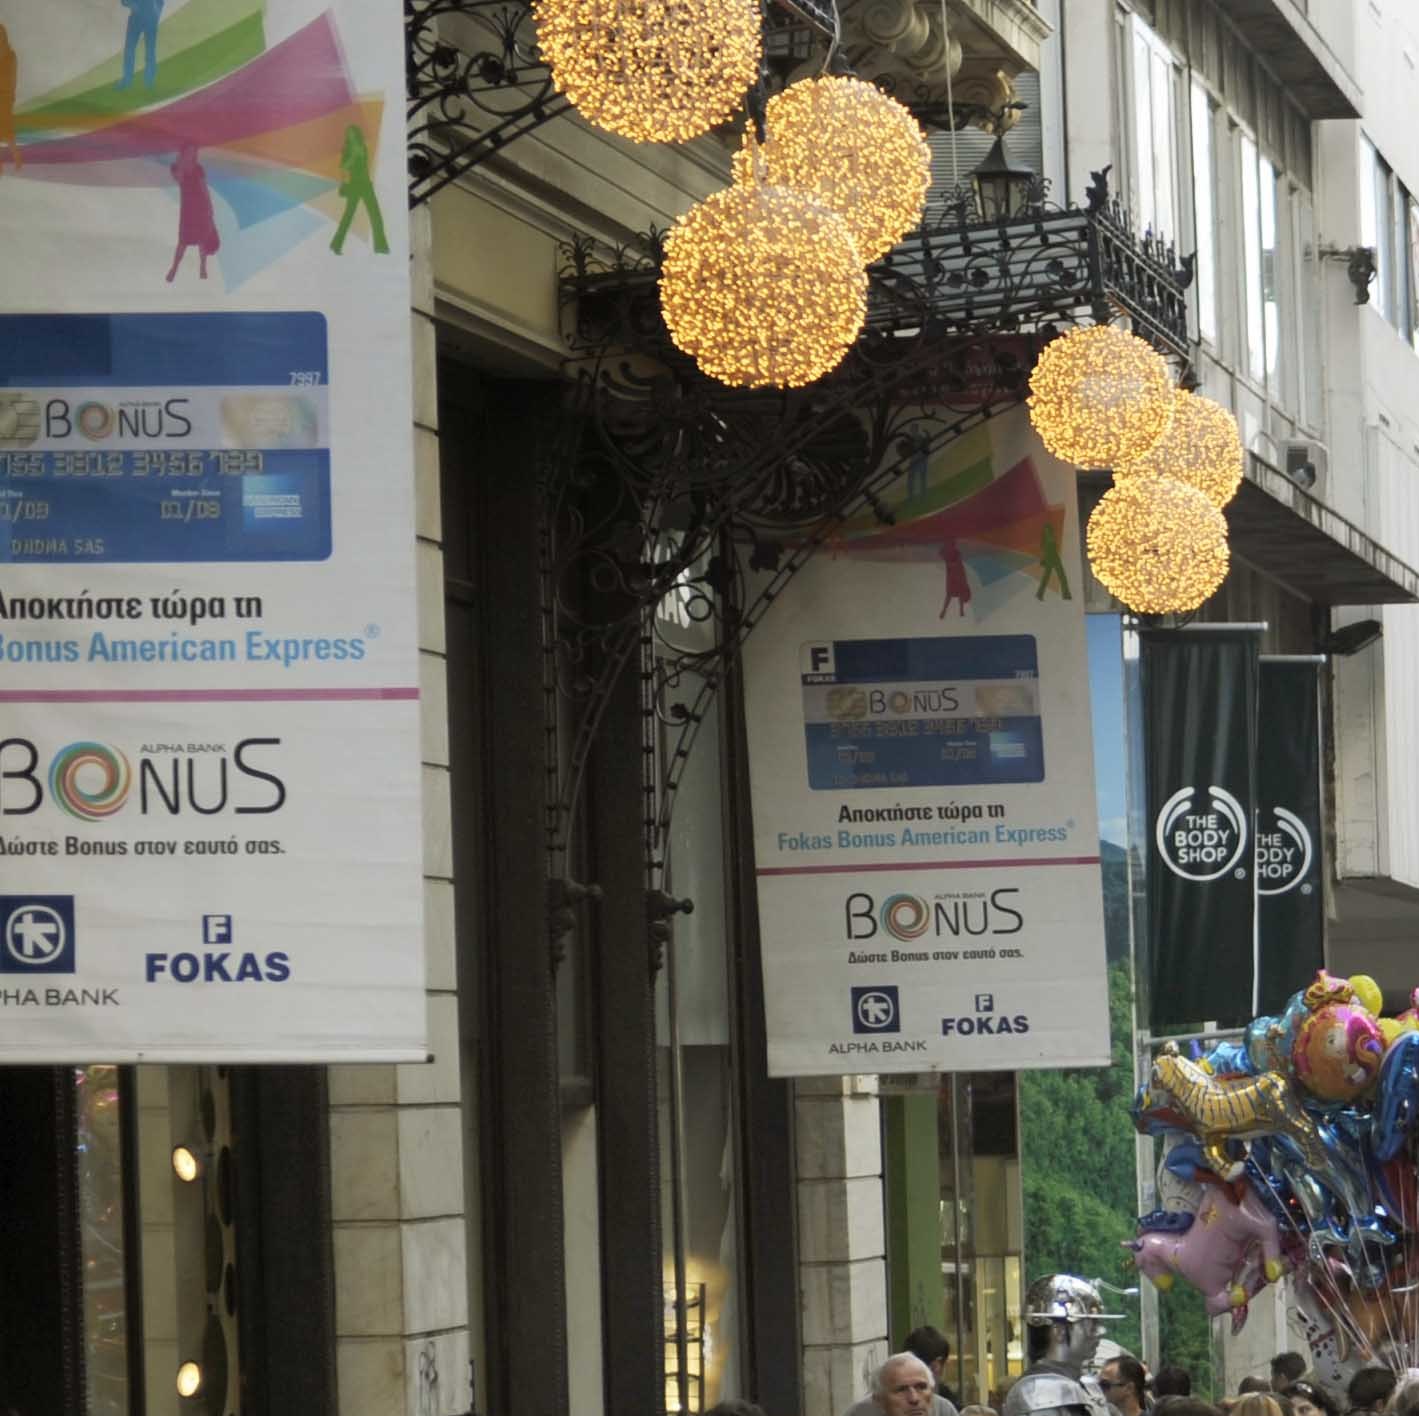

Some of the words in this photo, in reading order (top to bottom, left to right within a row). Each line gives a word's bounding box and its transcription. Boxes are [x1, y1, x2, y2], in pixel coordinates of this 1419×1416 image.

[46, 399, 192, 440] BONUS
[150, 588, 225, 625] τώρα
[234, 597, 263, 619] τη
[0, 632, 80, 662] onus
[88, 631, 236, 662] American
[245, 629, 366, 668] Express
[869, 687, 959, 714] BONUS
[139, 744, 184, 753] ALPHA
[186, 743, 226, 752] BANK
[838, 802, 933, 825] Αποκτήστε
[936, 800, 982, 826] τώρα
[987, 803, 1006, 819] τη
[1186, 815, 1218, 829] THE
[65, 835, 128, 856] Bonus
[134, 838, 177, 856] στον
[184, 834, 238, 856] εαυτό
[777, 831, 832, 851] Fokas
[838, 829, 896, 849] Bonus
[901, 827, 990, 847] American
[995, 824, 1067, 847] Express
[1175, 829, 1230, 847] BODY
[1178, 847, 1227, 864] SHOP
[845, 887, 1024, 943] BONUS
[145, 951, 291, 983] FOKAS
[847, 950, 888, 965] Δώστε
[891, 949, 930, 963] Bonus
[932, 949, 961, 962] στον
[963, 947, 997, 960] εαυτό
[45, 988, 120, 1007] BANK
[941, 1015, 1030, 1036] FOKAS
[828, 1042, 879, 1055] ALPHA
[882, 1040, 927, 1053] BANK
